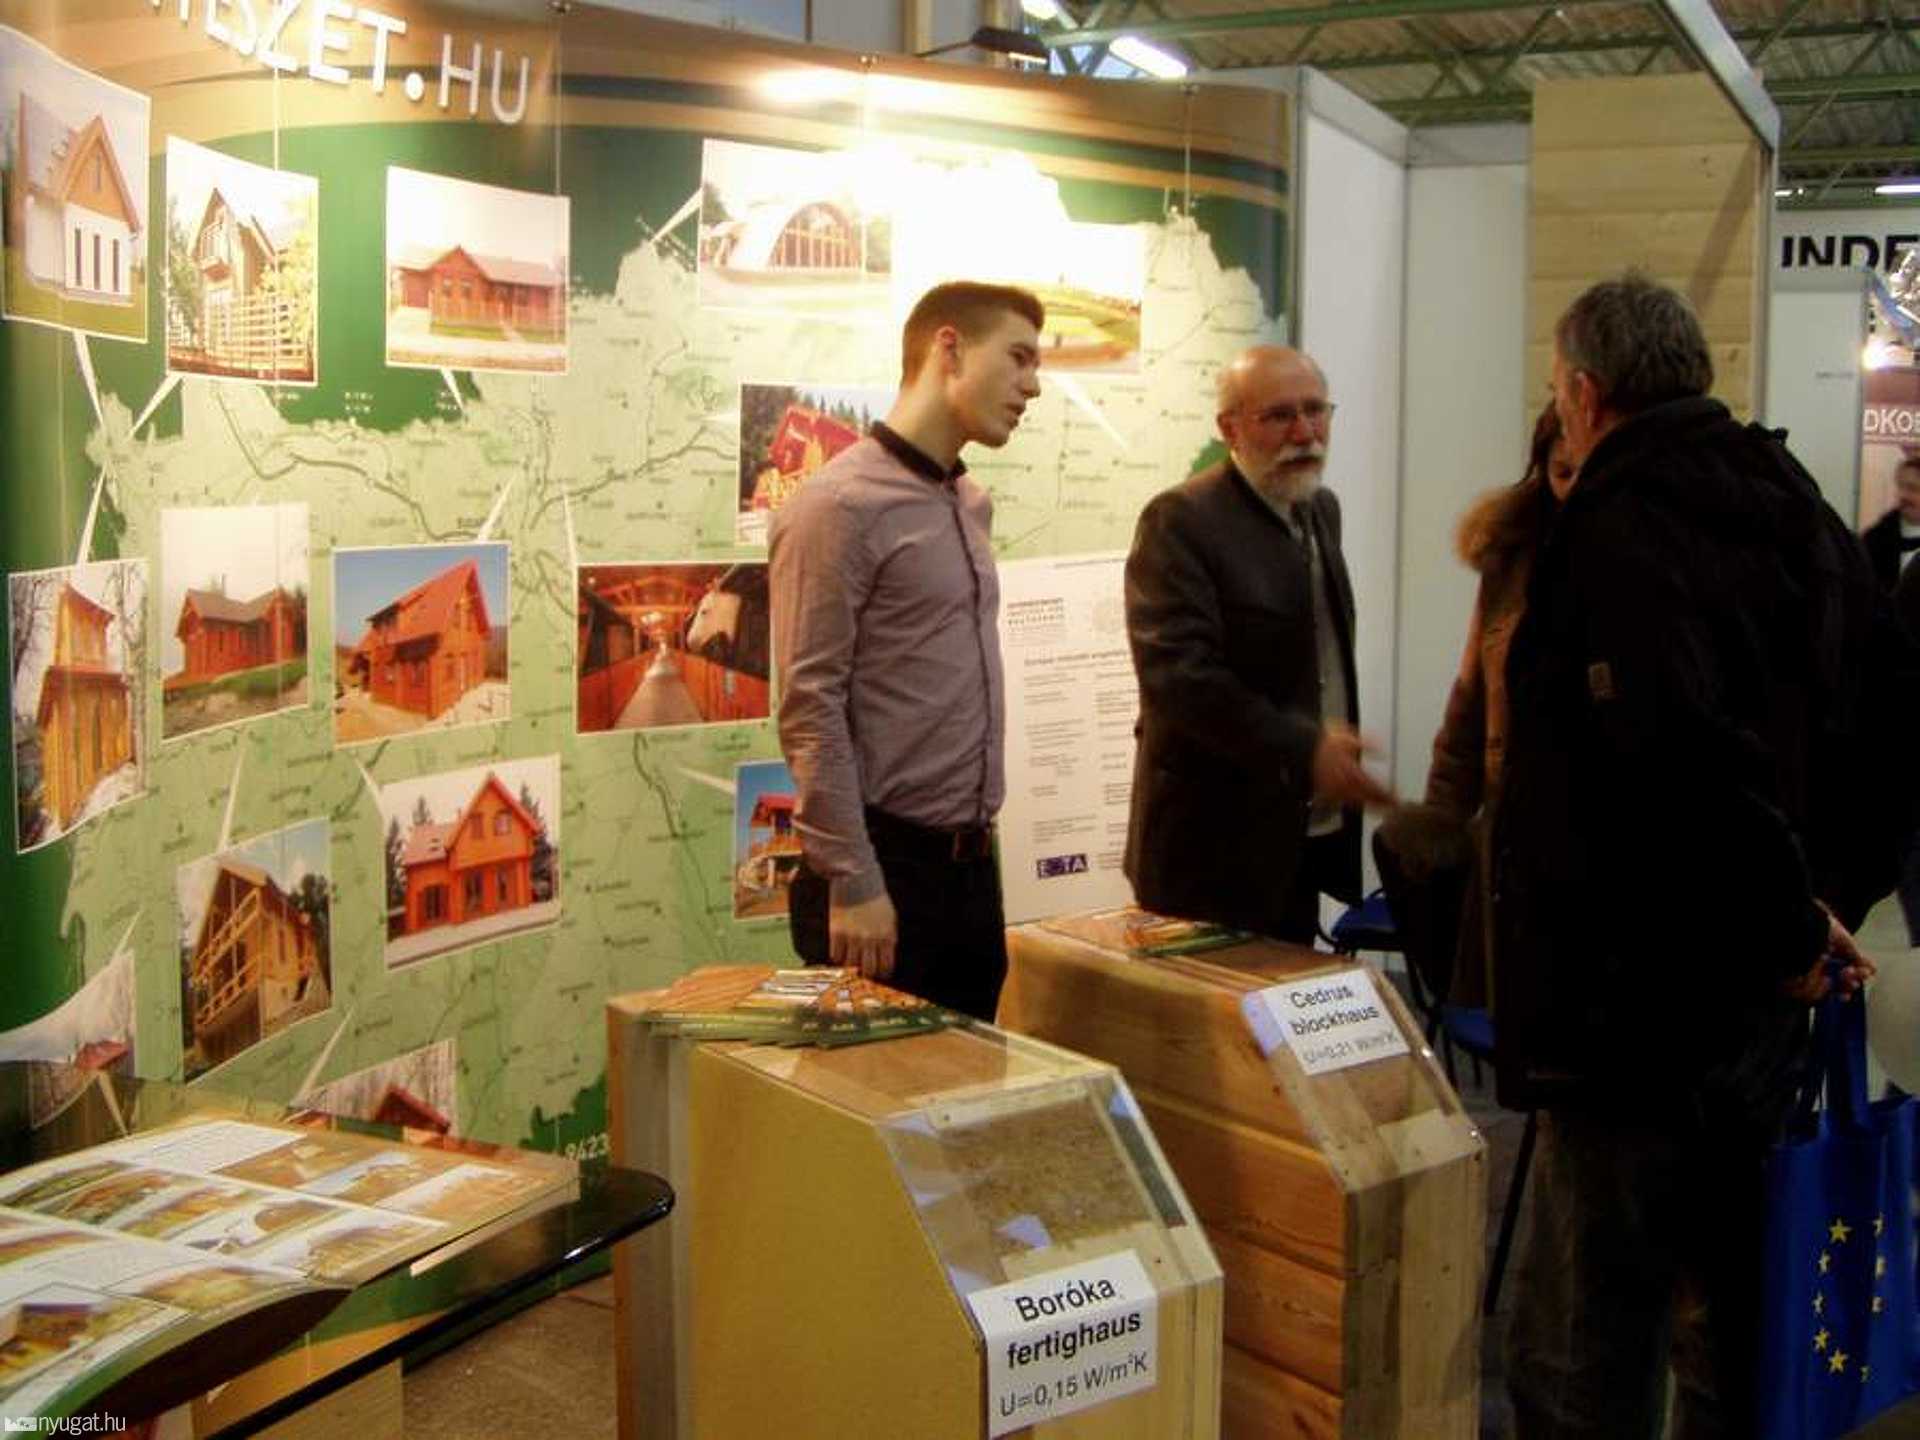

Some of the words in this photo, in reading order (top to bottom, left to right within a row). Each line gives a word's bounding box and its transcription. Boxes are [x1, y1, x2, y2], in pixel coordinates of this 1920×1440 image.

[1290, 985, 1354, 1008] Cedrus
[1289, 1006, 1379, 1035] blockhaus
[1015, 1279, 1115, 1321] Boróka
[1007, 1312, 1141, 1368] fertighaus
[1001, 1376, 1078, 1416] U=0,15
